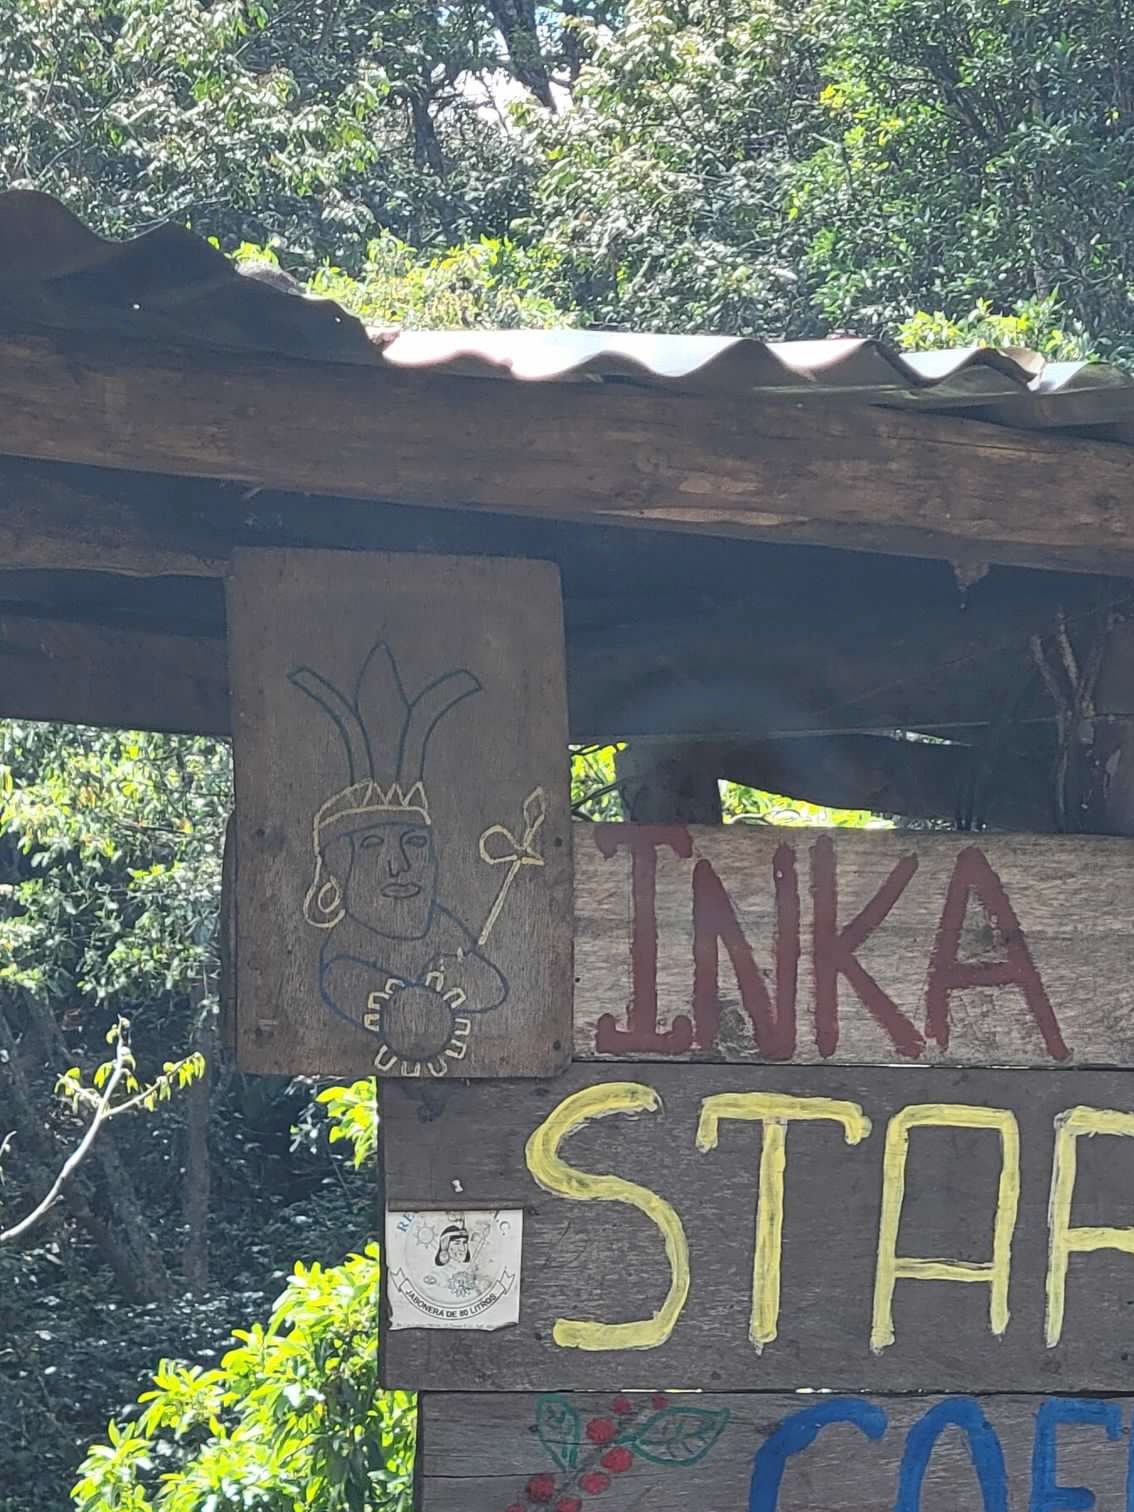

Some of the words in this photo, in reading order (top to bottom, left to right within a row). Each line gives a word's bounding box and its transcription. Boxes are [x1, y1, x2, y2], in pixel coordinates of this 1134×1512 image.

[595, 824, 1075, 1061] INKA
[446, 1310, 457, 1318] DE
[469, 1293, 497, 1314] LITROS
